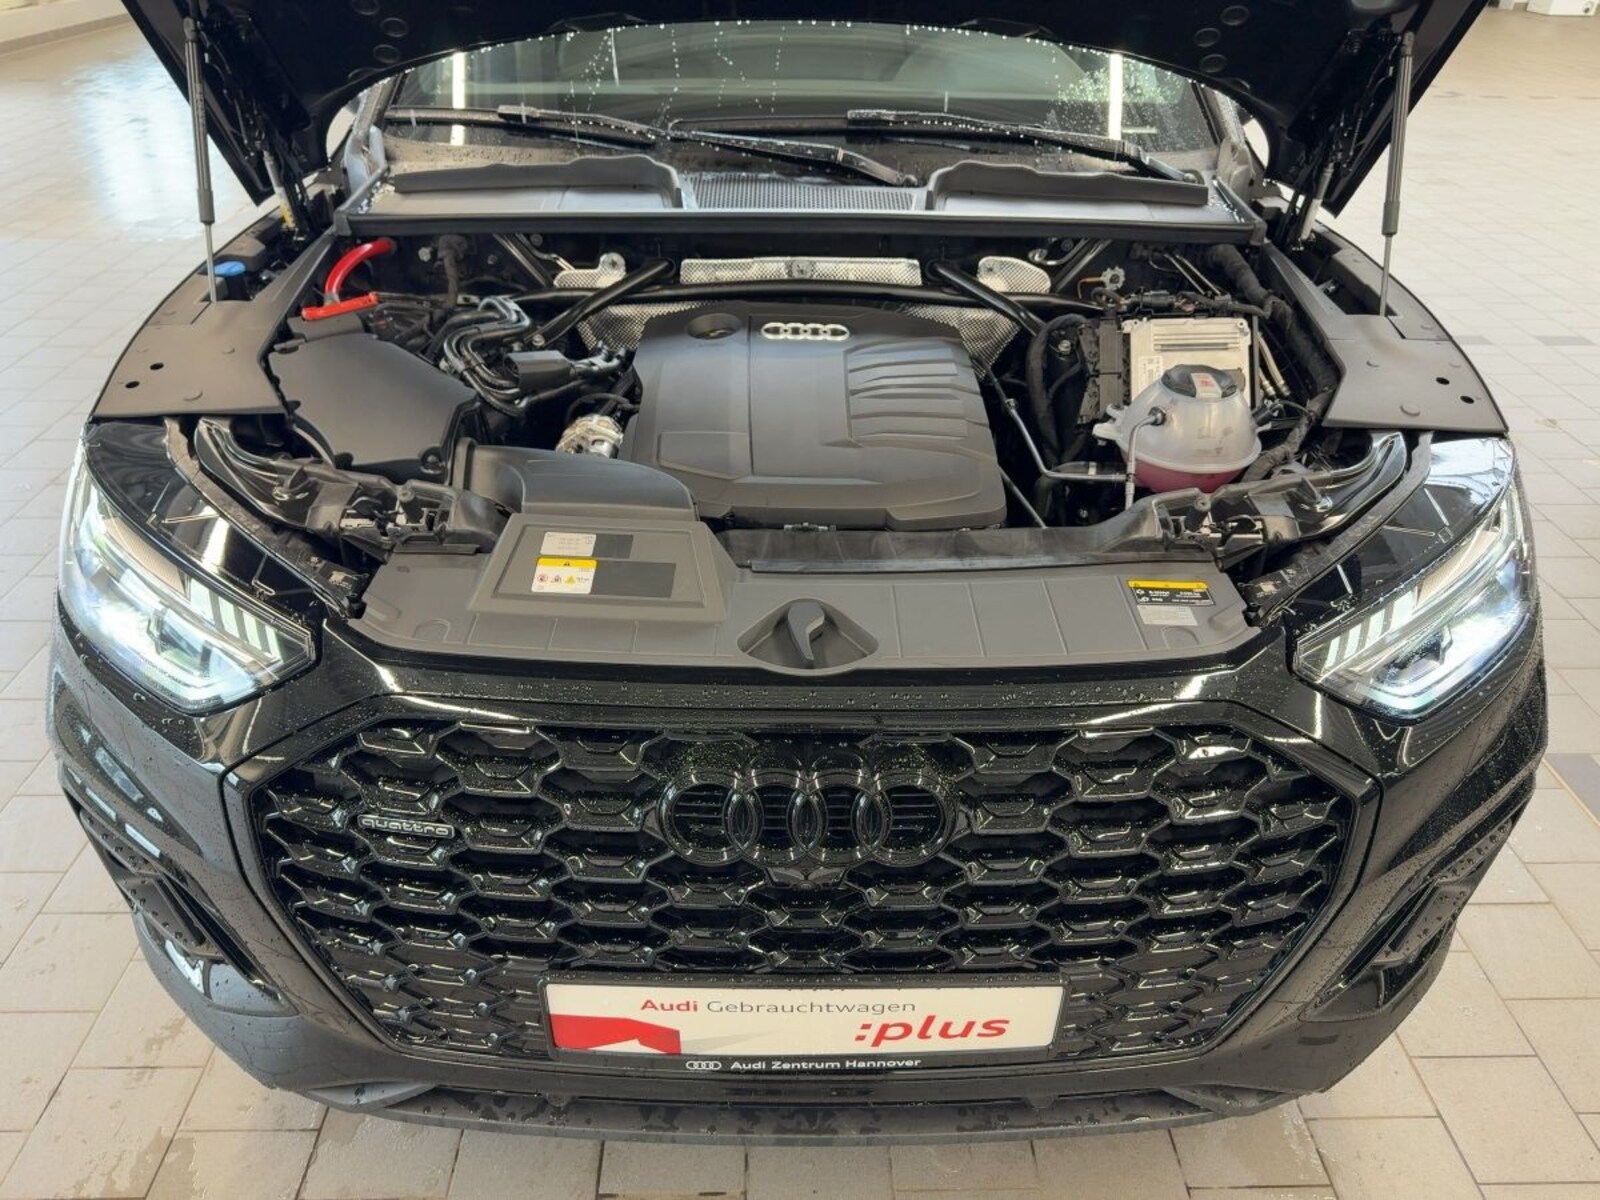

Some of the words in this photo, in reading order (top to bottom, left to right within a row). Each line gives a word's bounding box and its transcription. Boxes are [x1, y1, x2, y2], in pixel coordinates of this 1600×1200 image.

[361, 818, 449, 836] quattro
[641, 999, 698, 1012] Audi
[707, 1001, 916, 1015] Gebrauchtwagen
[855, 1014, 1010, 1048] :plus
[730, 1061, 765, 1070] Audi
[771, 1060, 841, 1070] Zentrum
[845, 1058, 922, 1069] Hannover
